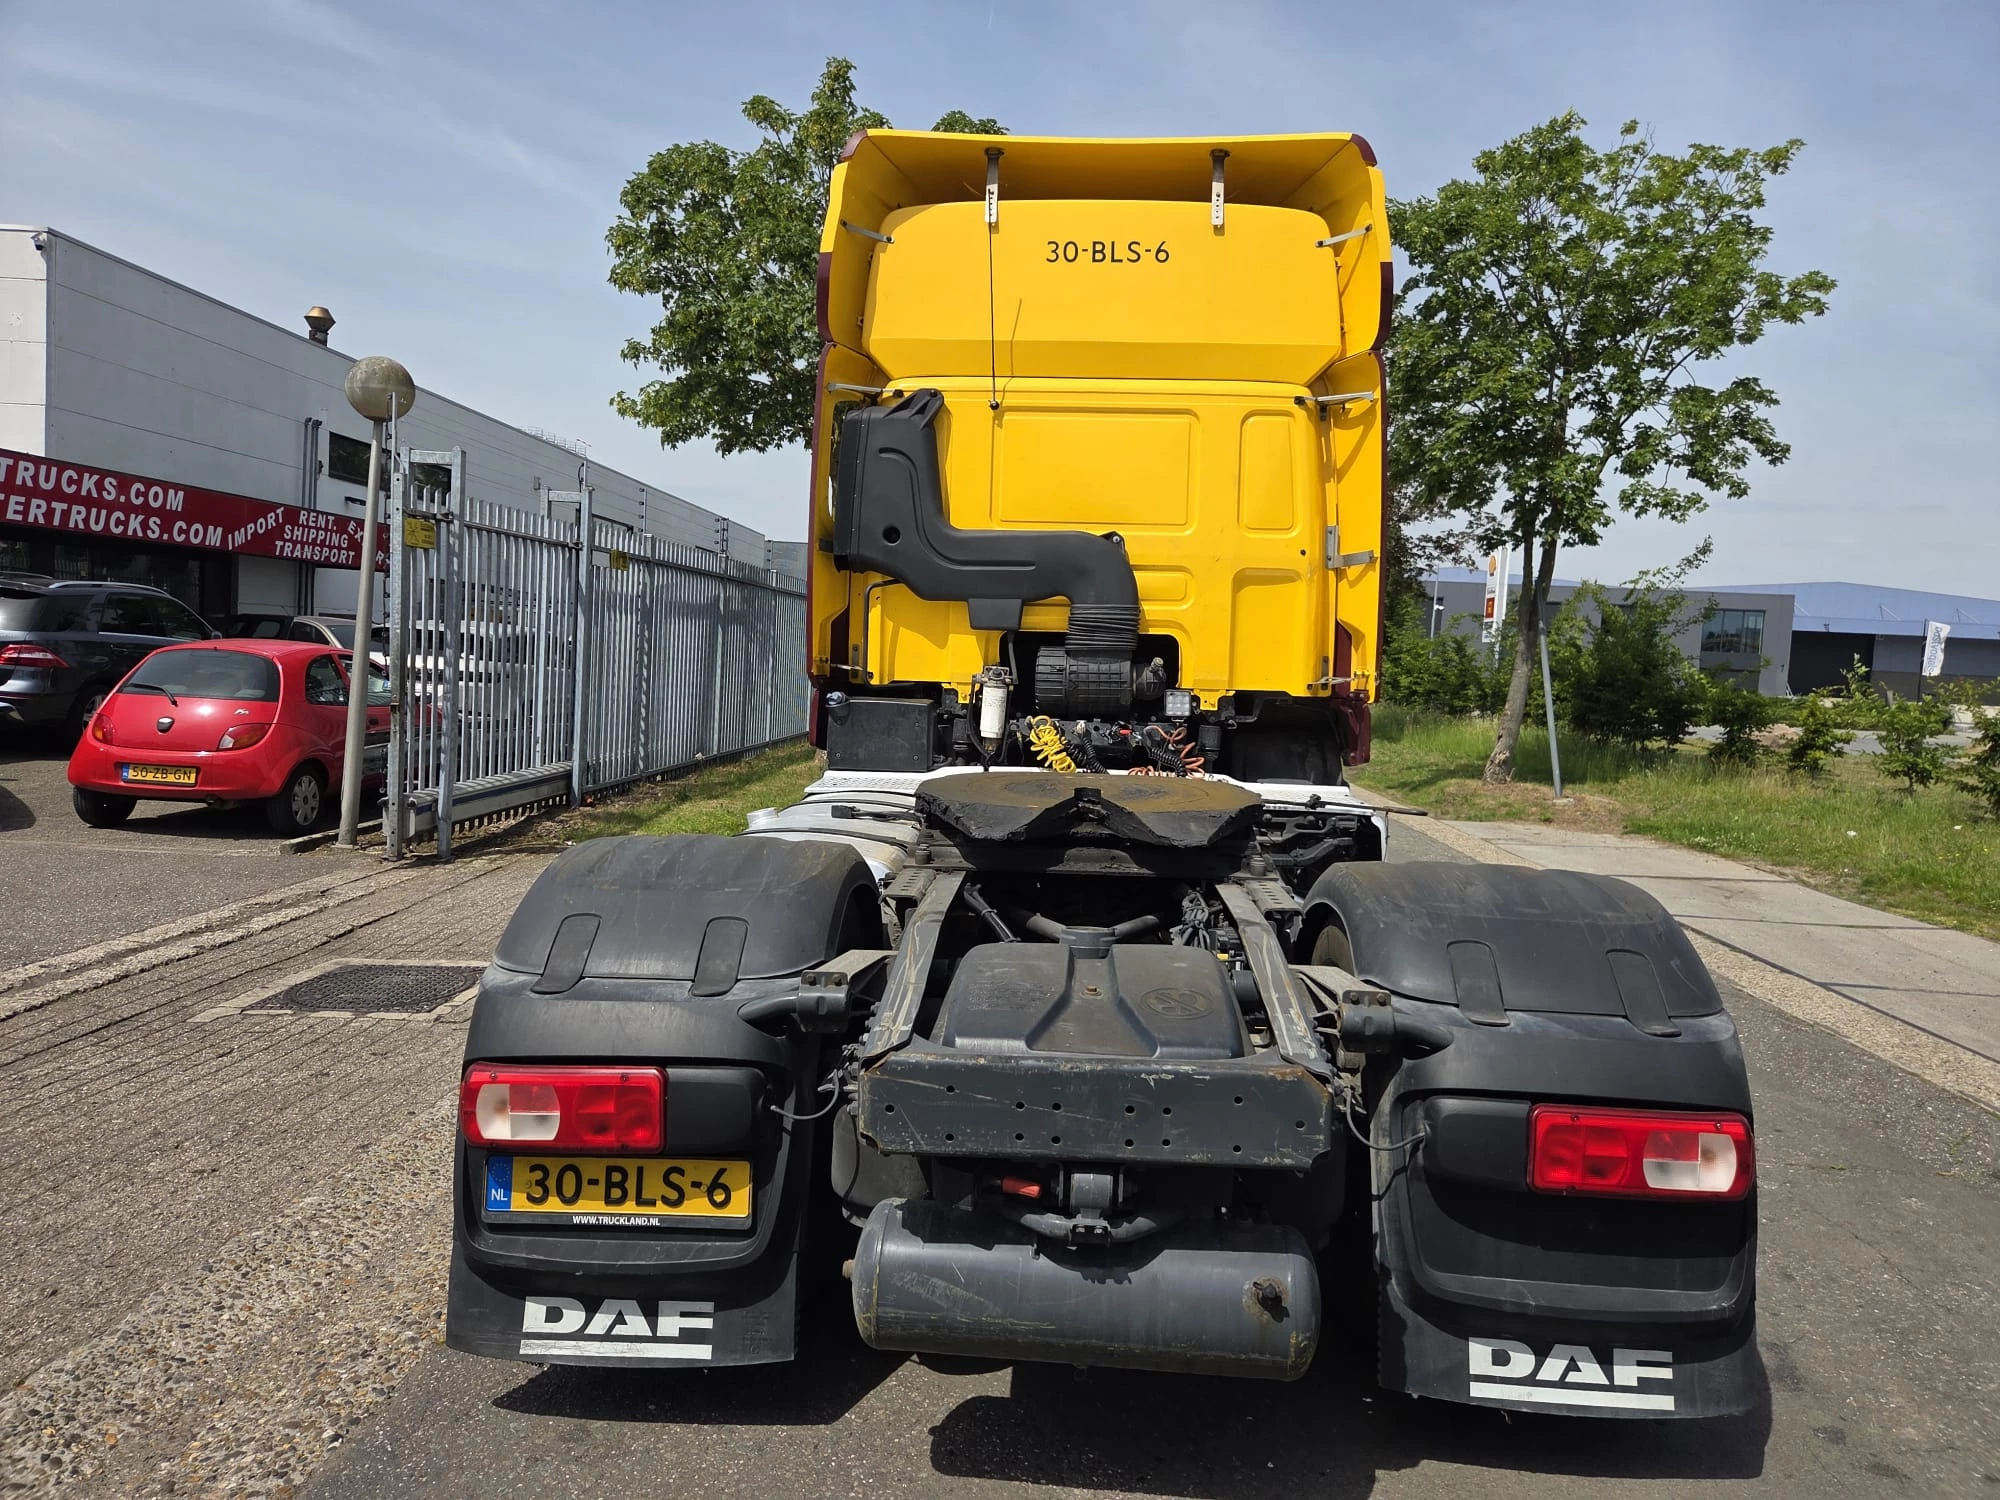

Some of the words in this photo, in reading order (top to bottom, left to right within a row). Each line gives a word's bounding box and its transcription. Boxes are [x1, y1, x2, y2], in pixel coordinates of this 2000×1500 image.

[1046, 241, 1170, 263] 30-BLS-6
[0, 493, 223, 547] ERTRUCKS.COM
[227, 506, 285, 550] IMPORT
[299, 510, 337, 531] RENT.
[283, 524, 349, 548] SHIPPING
[274, 540, 356, 565] TRANSPORT
[132, 766, 192, 781] 50-ZB-GN
[491, 1188, 508, 1201] NL
[526, 1163, 732, 1209] 30-BLS-6
[572, 1215, 661, 1227] WWW.TRUCKLAND.NL
[522, 1296, 715, 1337] DAF
[1469, 1337, 1673, 1387] DAF
